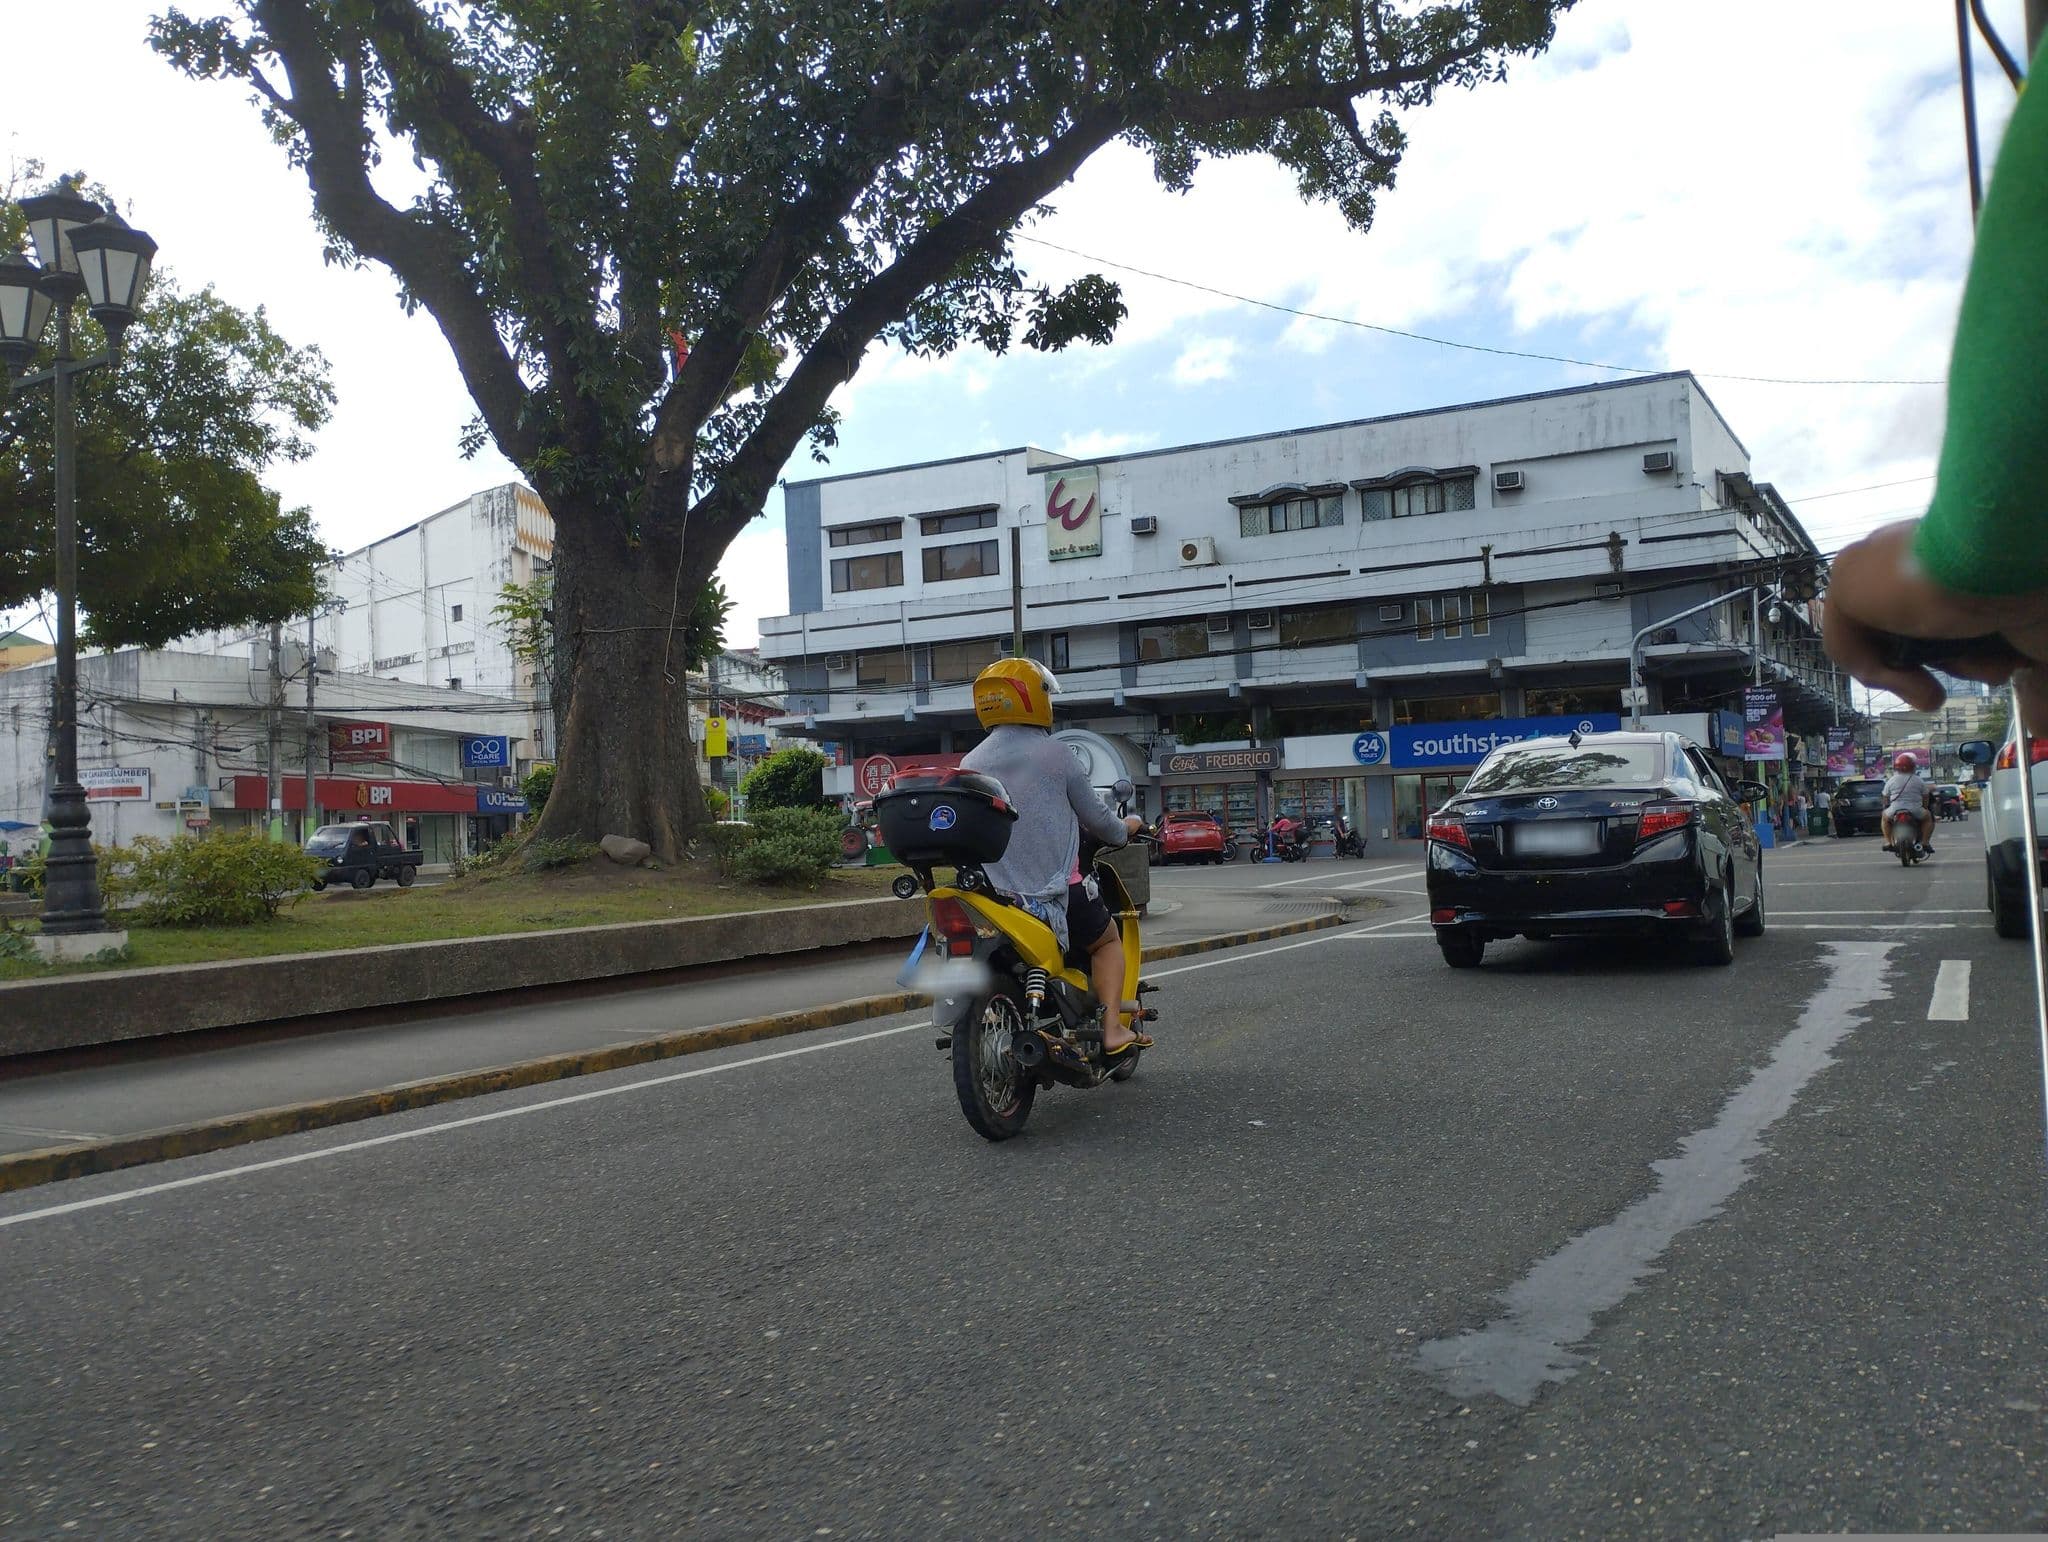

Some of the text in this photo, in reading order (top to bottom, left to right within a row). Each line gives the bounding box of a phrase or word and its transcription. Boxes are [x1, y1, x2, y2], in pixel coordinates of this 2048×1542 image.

[352, 728, 383, 745] BPI
[1358, 738, 1380, 753] 24
[1206, 752, 1271, 769] FREDERICO
[113, 769, 147, 777] LUMBER
[370, 786, 392, 805] BPI
